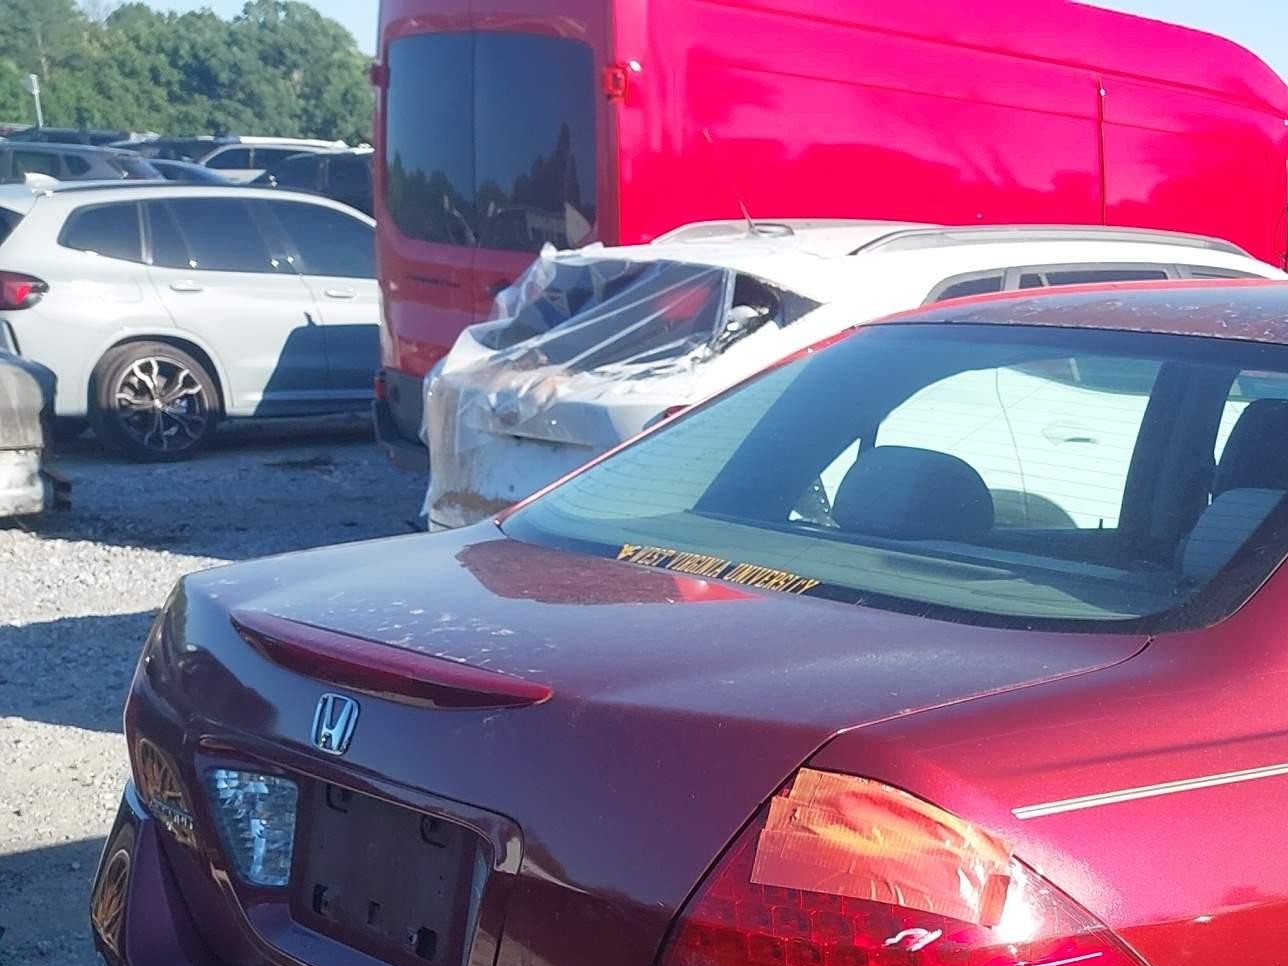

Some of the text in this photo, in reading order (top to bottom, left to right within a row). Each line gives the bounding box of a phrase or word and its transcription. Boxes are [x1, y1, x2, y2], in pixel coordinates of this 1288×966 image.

[630, 546, 676, 566] WEST
[665, 552, 732, 577] VIRGINIA
[723, 563, 819, 594] UNIVERSITY
